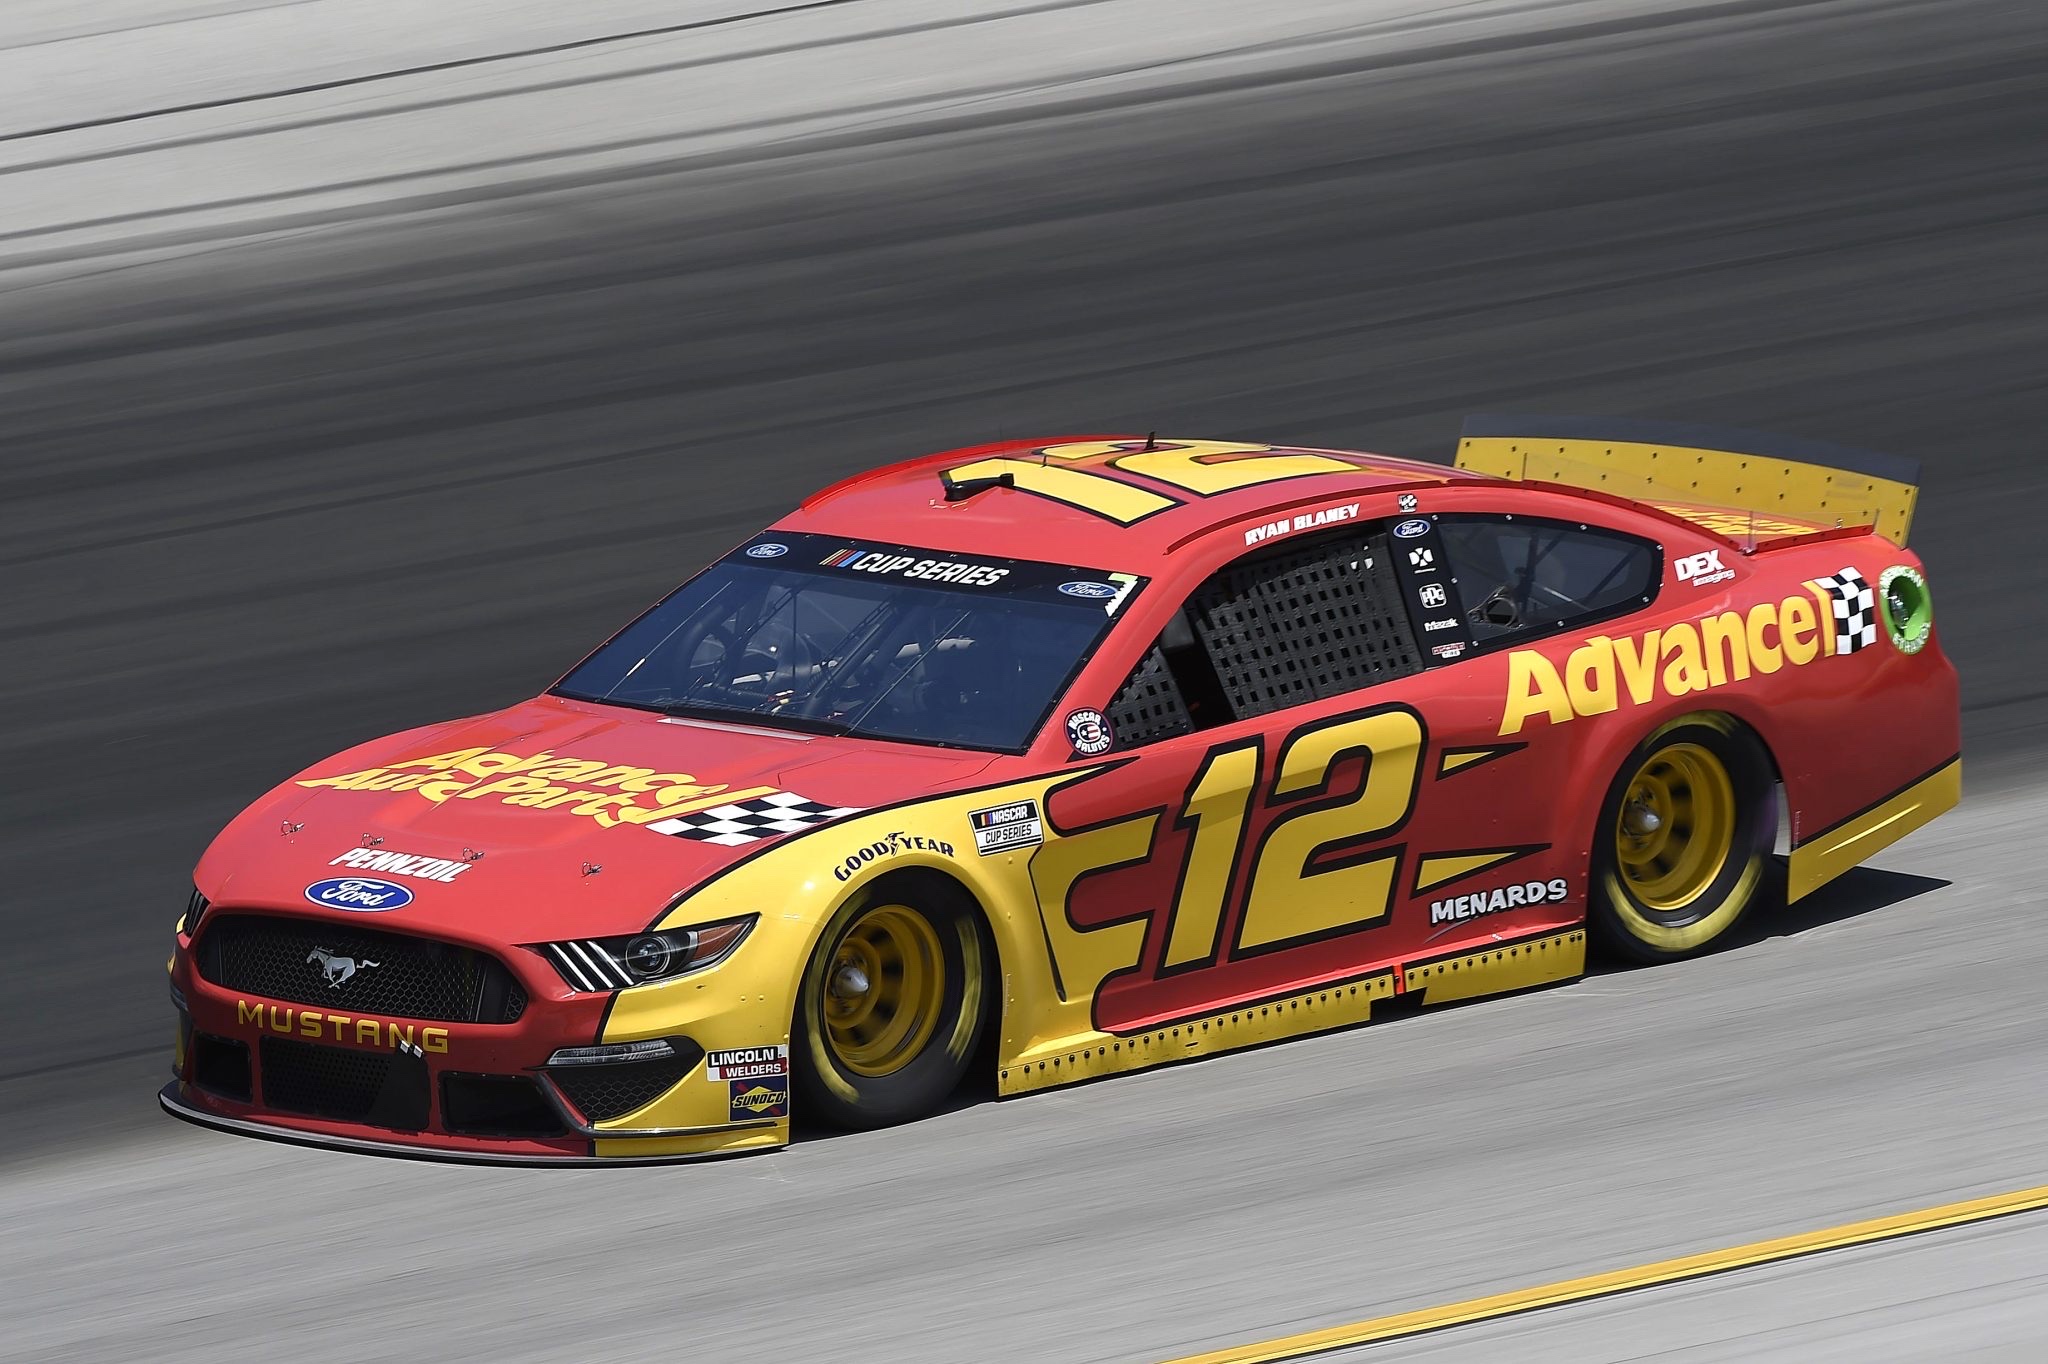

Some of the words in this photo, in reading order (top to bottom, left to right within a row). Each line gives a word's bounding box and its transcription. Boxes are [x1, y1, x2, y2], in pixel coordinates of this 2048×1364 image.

[1244, 518, 1291, 547] RYAN
[1293, 503, 1361, 531] BLANEY
[852, 552, 909, 574] CUP
[904, 560, 1010, 587] SERIES
[1673, 550, 1726, 582] DEX
[1499, 592, 1826, 736] Advance
[1068, 711, 1102, 730] NASCAR
[1075, 734, 1110, 753] SALUTES
[383, 746, 729, 808] Advance
[295, 767, 476, 809] Auto
[457, 776, 642, 829] Parts
[991, 805, 1029, 825] NASCAR
[985, 829, 1002, 844] CUP
[1002, 824, 1033, 840] SERIES
[1155, 702, 1427, 980] 12
[328, 847, 473, 883] PENNZOIL
[320, 879, 396, 907] Ford
[1429, 876, 1570, 926] MENARDS
[237, 999, 450, 1055] MUSTANG
[710, 1047, 776, 1067] LINCOLN
[725, 1063, 782, 1078] WELDERS
[733, 1092, 785, 1108] SUNOCO
